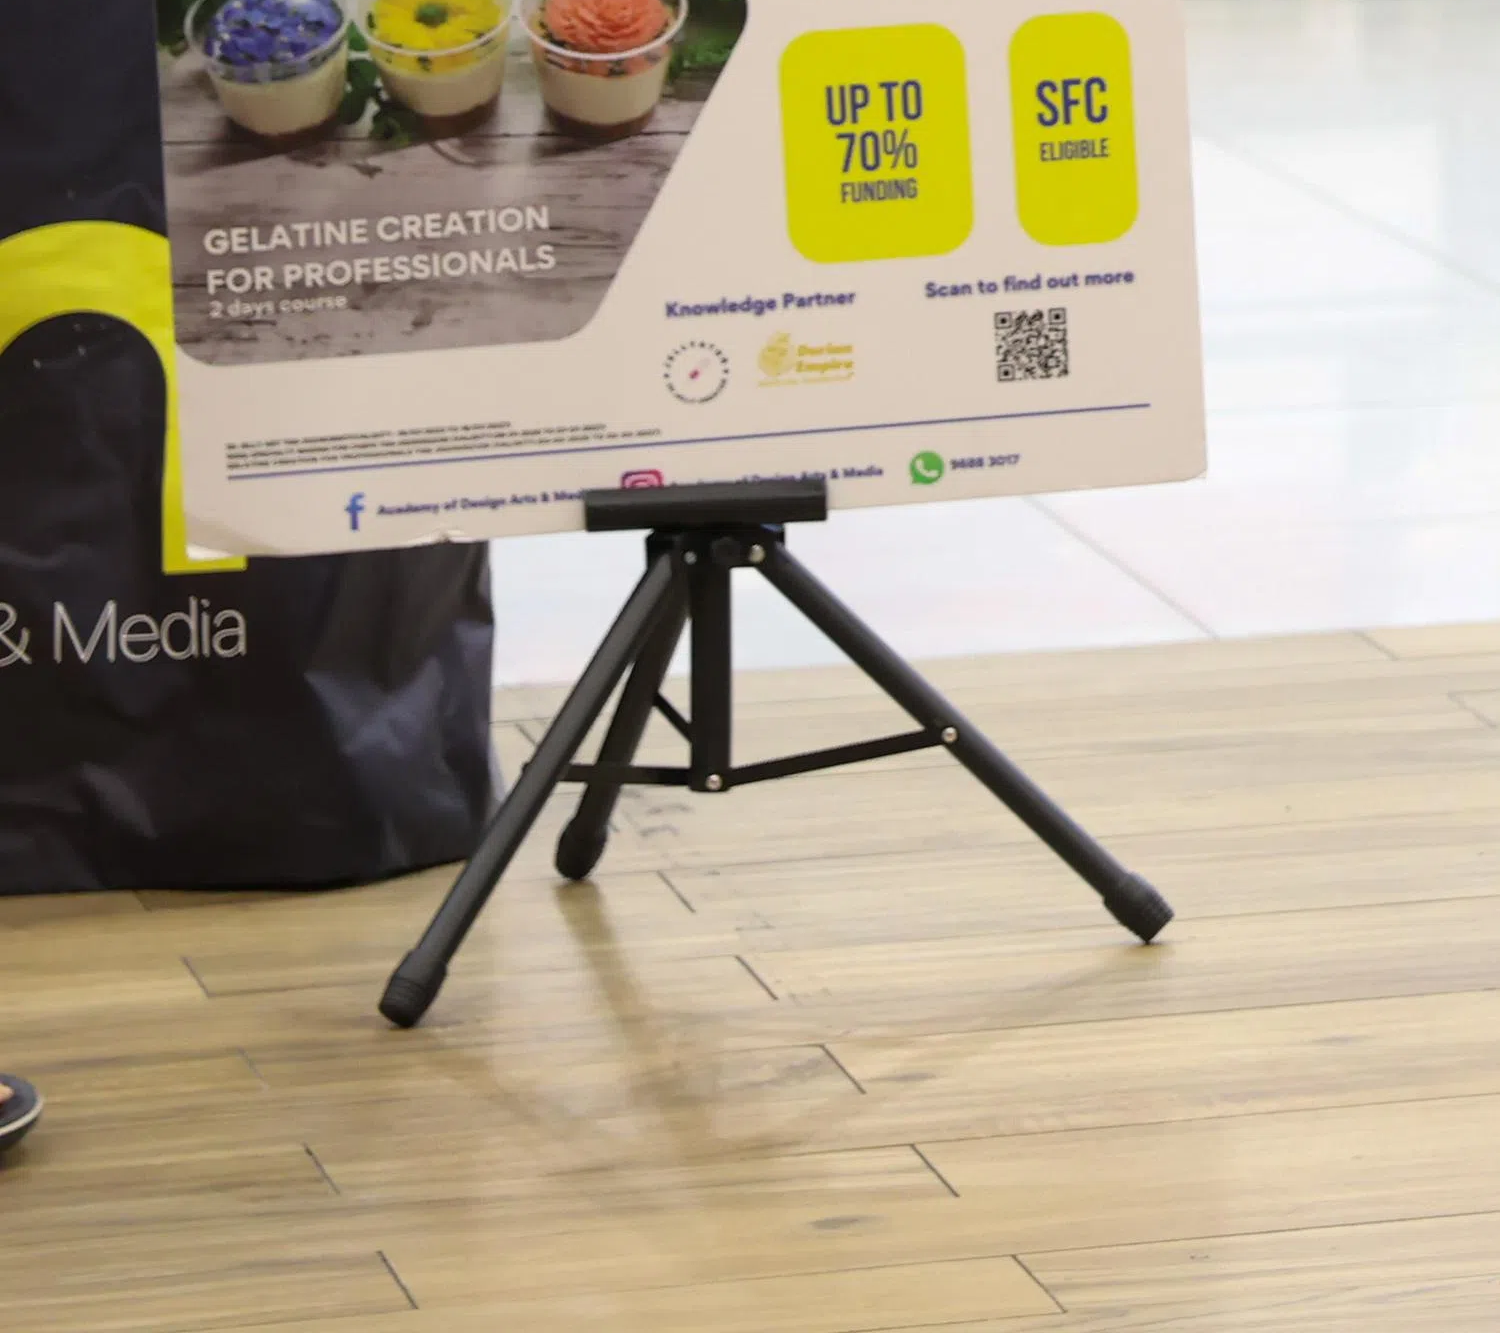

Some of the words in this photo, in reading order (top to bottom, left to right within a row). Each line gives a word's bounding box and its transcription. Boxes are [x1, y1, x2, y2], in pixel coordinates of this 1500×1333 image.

[825, 84, 870, 126] UP
[879, 80, 923, 122] TO
[1036, 76, 1109, 127] SFC
[835, 128, 918, 173] 70%
[1040, 137, 1109, 162] ELIGIBLE
[841, 178, 918, 204] FUNDING
[203, 218, 368, 255] GELATINE
[376, 206, 550, 243] CREATION
[206, 267, 275, 296] FOR
[283, 244, 556, 289] PROFESSIONALS
[925, 281, 973, 299] Scan
[977, 278, 998, 295] to
[1003, 274, 1042, 294] find
[1046, 273, 1080, 291] out
[1084, 270, 1135, 288] more
[209, 300, 223, 318] 2
[227, 296, 275, 319] days
[279, 294, 347, 314] course
[665, 295, 777, 319] Knowledge
[782, 289, 856, 311] Partner
[988, 453, 1020, 468] 3017
[377, 500, 440, 518] Academy
[443, 498, 457, 513] of
[460, 494, 508, 515] Design
[510, 492, 537, 506] Arts
[541, 491, 550, 503] &
[53, 596, 247, 665] Media
